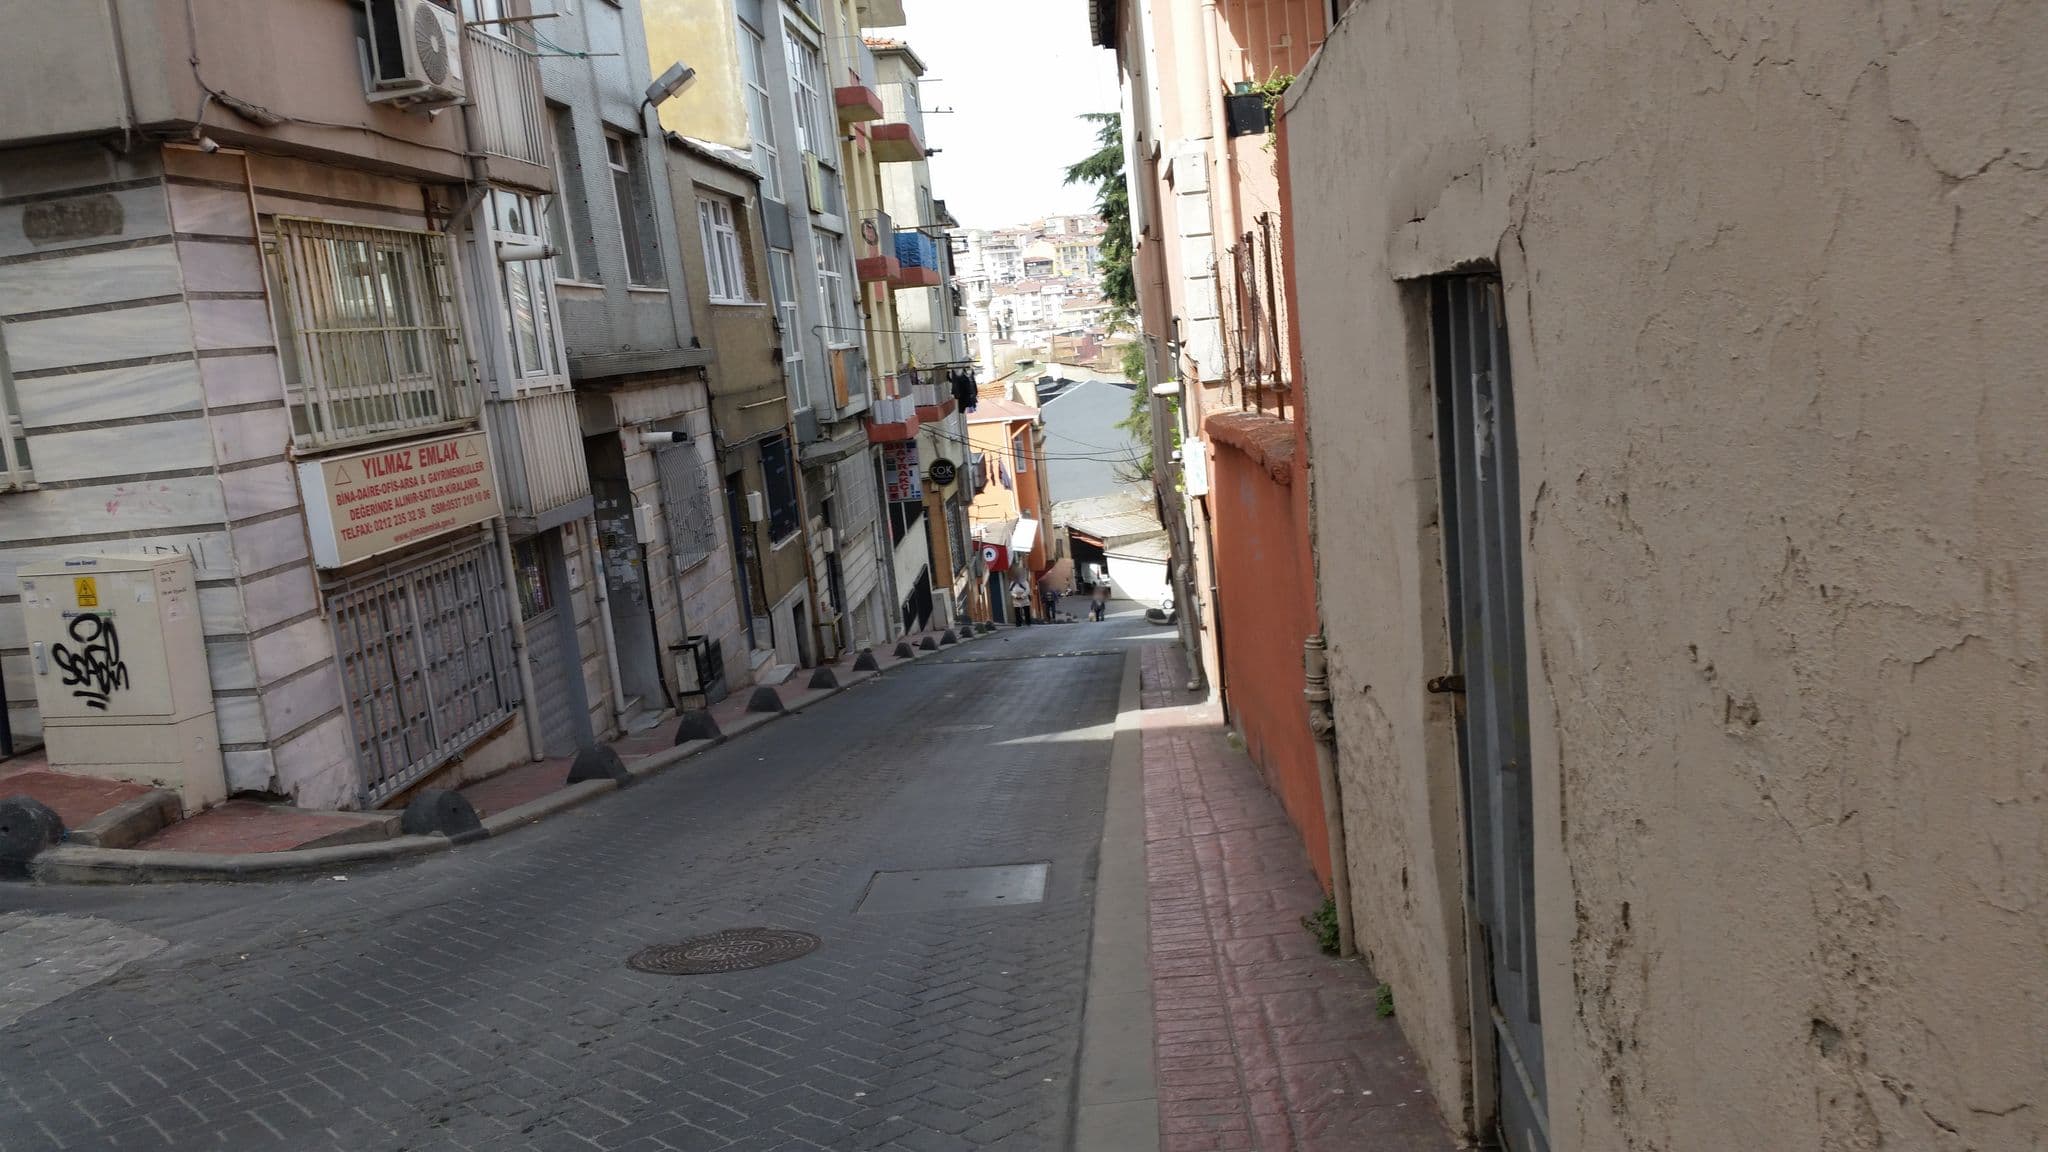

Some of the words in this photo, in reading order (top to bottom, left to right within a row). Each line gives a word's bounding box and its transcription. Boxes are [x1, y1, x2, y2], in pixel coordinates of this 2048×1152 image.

[361, 448, 413, 479] YILMAZ
[418, 441, 460, 468] EMLAK
[349, 498, 394, 521] DEĞERİNDE
[341, 522, 374, 542] TELFAX:
[374, 517, 392, 531] 0212
[406, 510, 416, 522] 32
